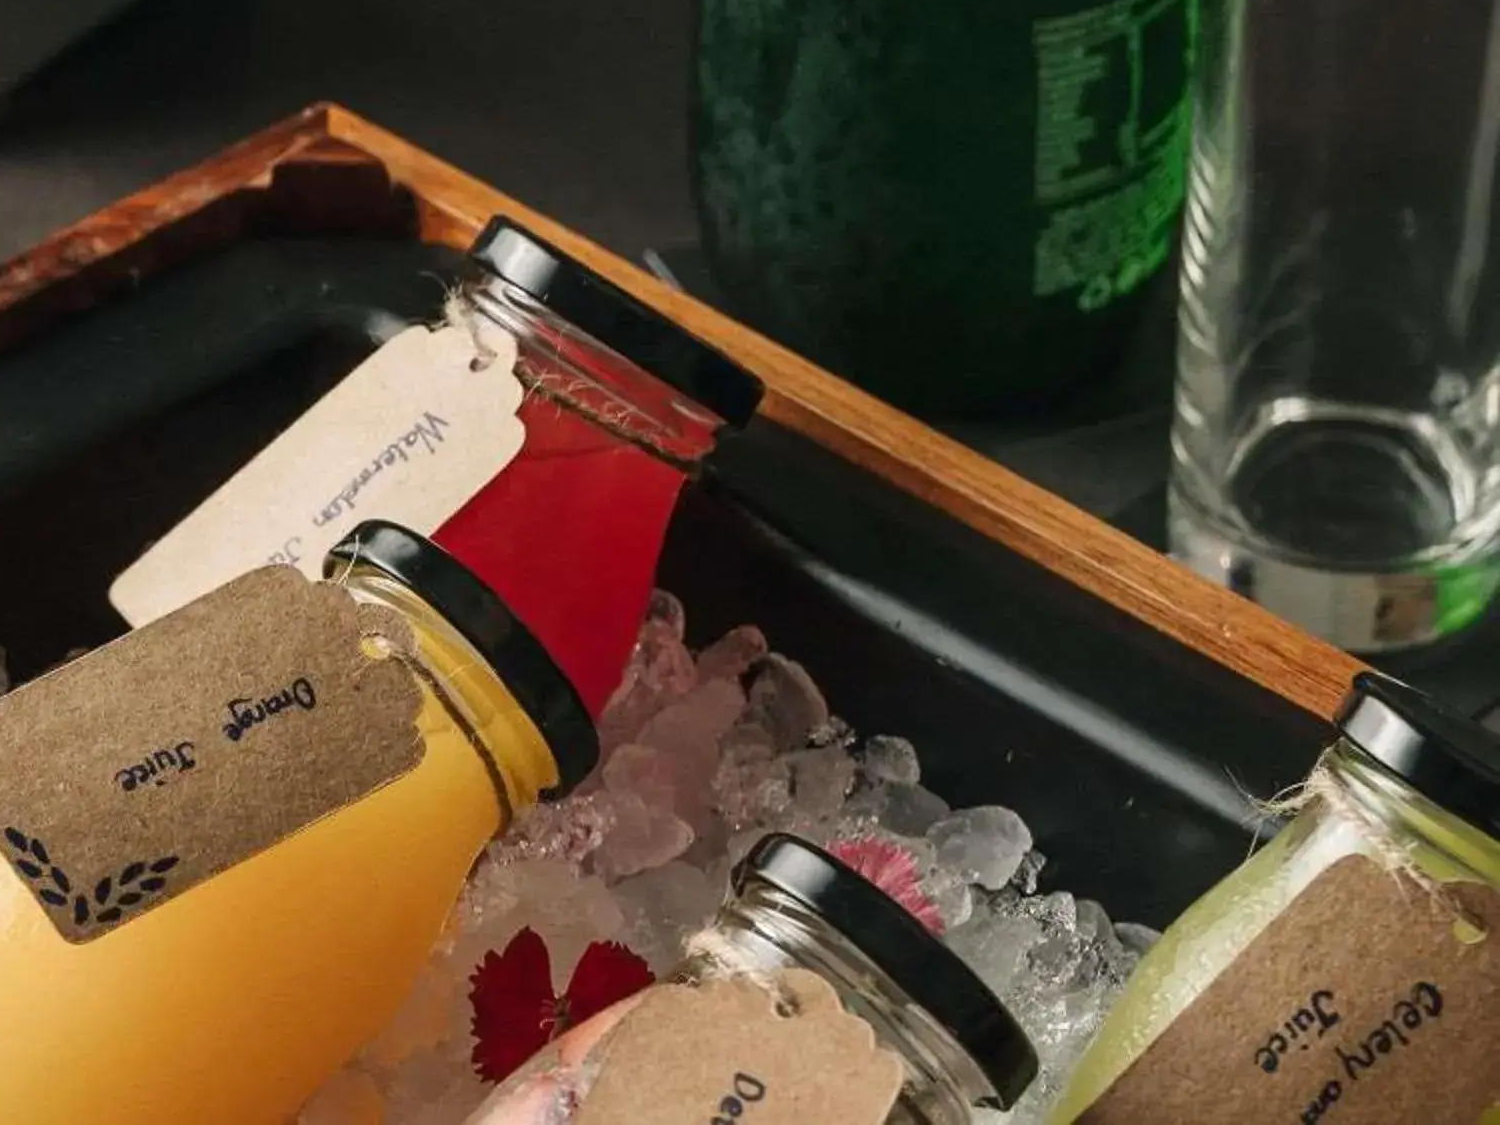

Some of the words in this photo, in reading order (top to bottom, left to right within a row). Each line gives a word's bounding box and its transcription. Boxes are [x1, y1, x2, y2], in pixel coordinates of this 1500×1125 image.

[312, 411, 450, 527] Watermelon
[222, 677, 316, 741] Orange
[114, 741, 196, 792] Juice
[1254, 990, 1340, 1073] Juice
[1334, 981, 1443, 1081] Celery
